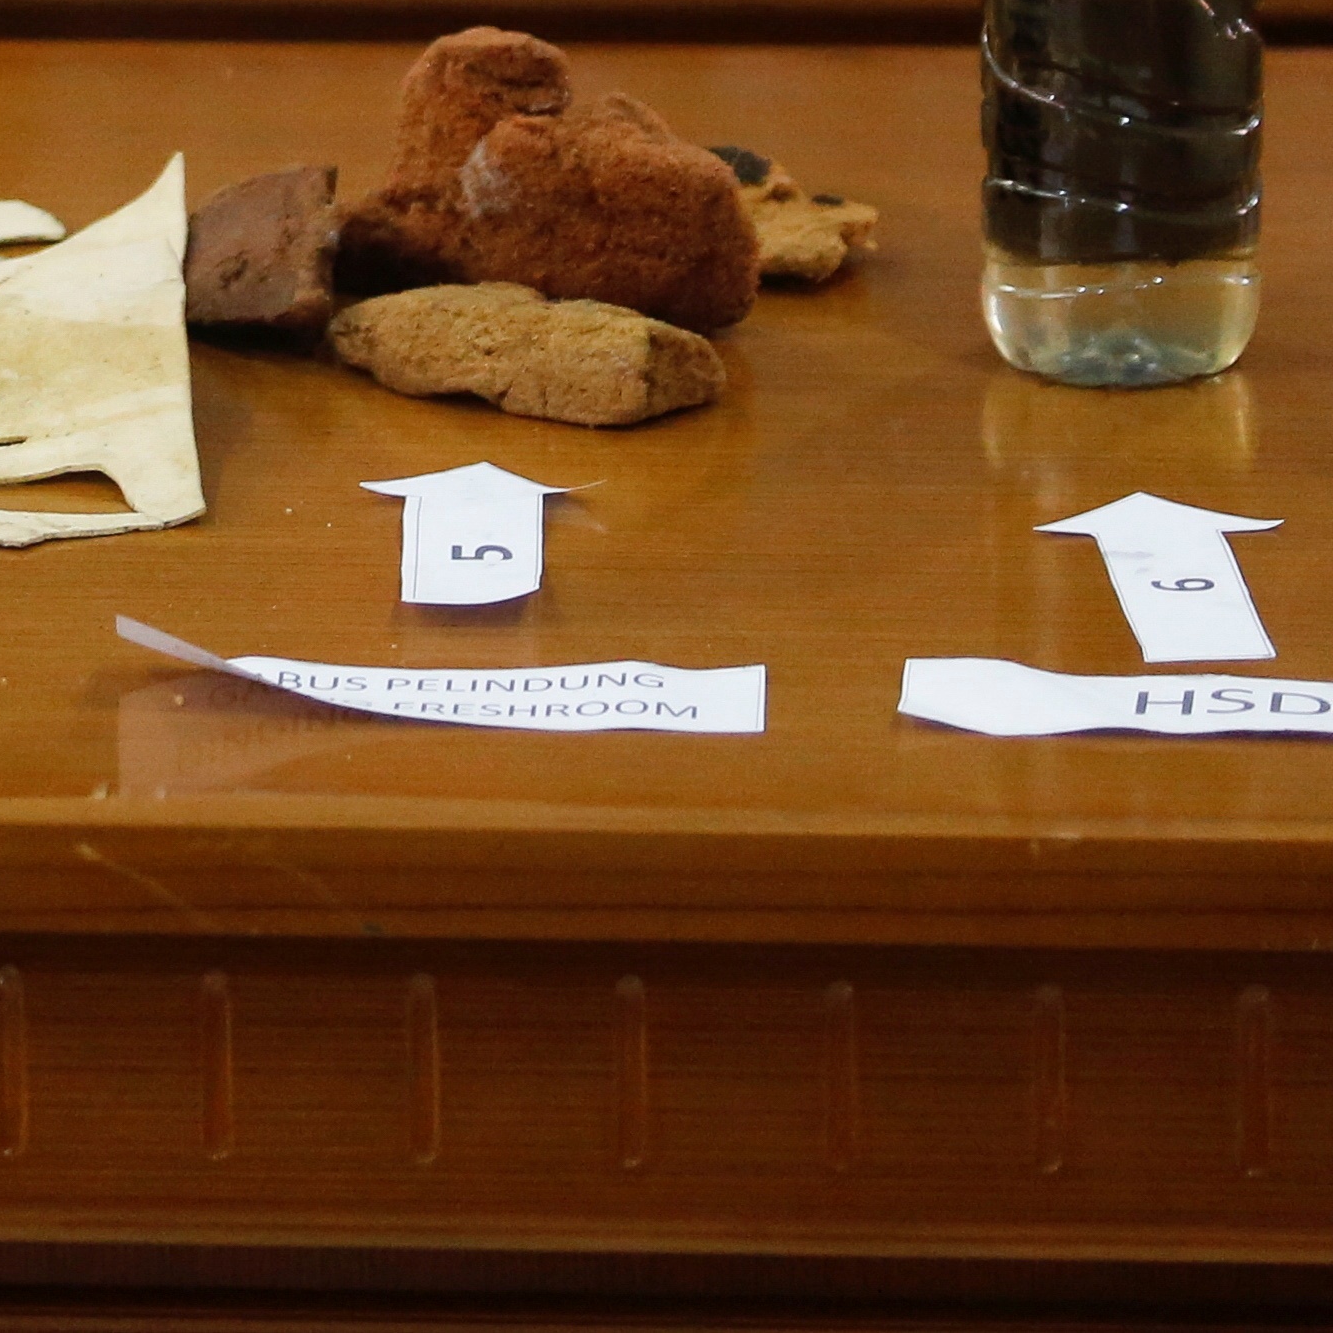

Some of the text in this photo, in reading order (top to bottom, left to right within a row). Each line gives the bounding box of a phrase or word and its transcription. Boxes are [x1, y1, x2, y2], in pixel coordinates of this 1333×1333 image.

[450, 544, 513, 561] 5
[1150, 577, 1215, 592] 6
[386, 671, 665, 692] PELINDUNG
[393, 699, 698, 720] FRESHROOM
[1134, 688, 1332, 716] HSD
